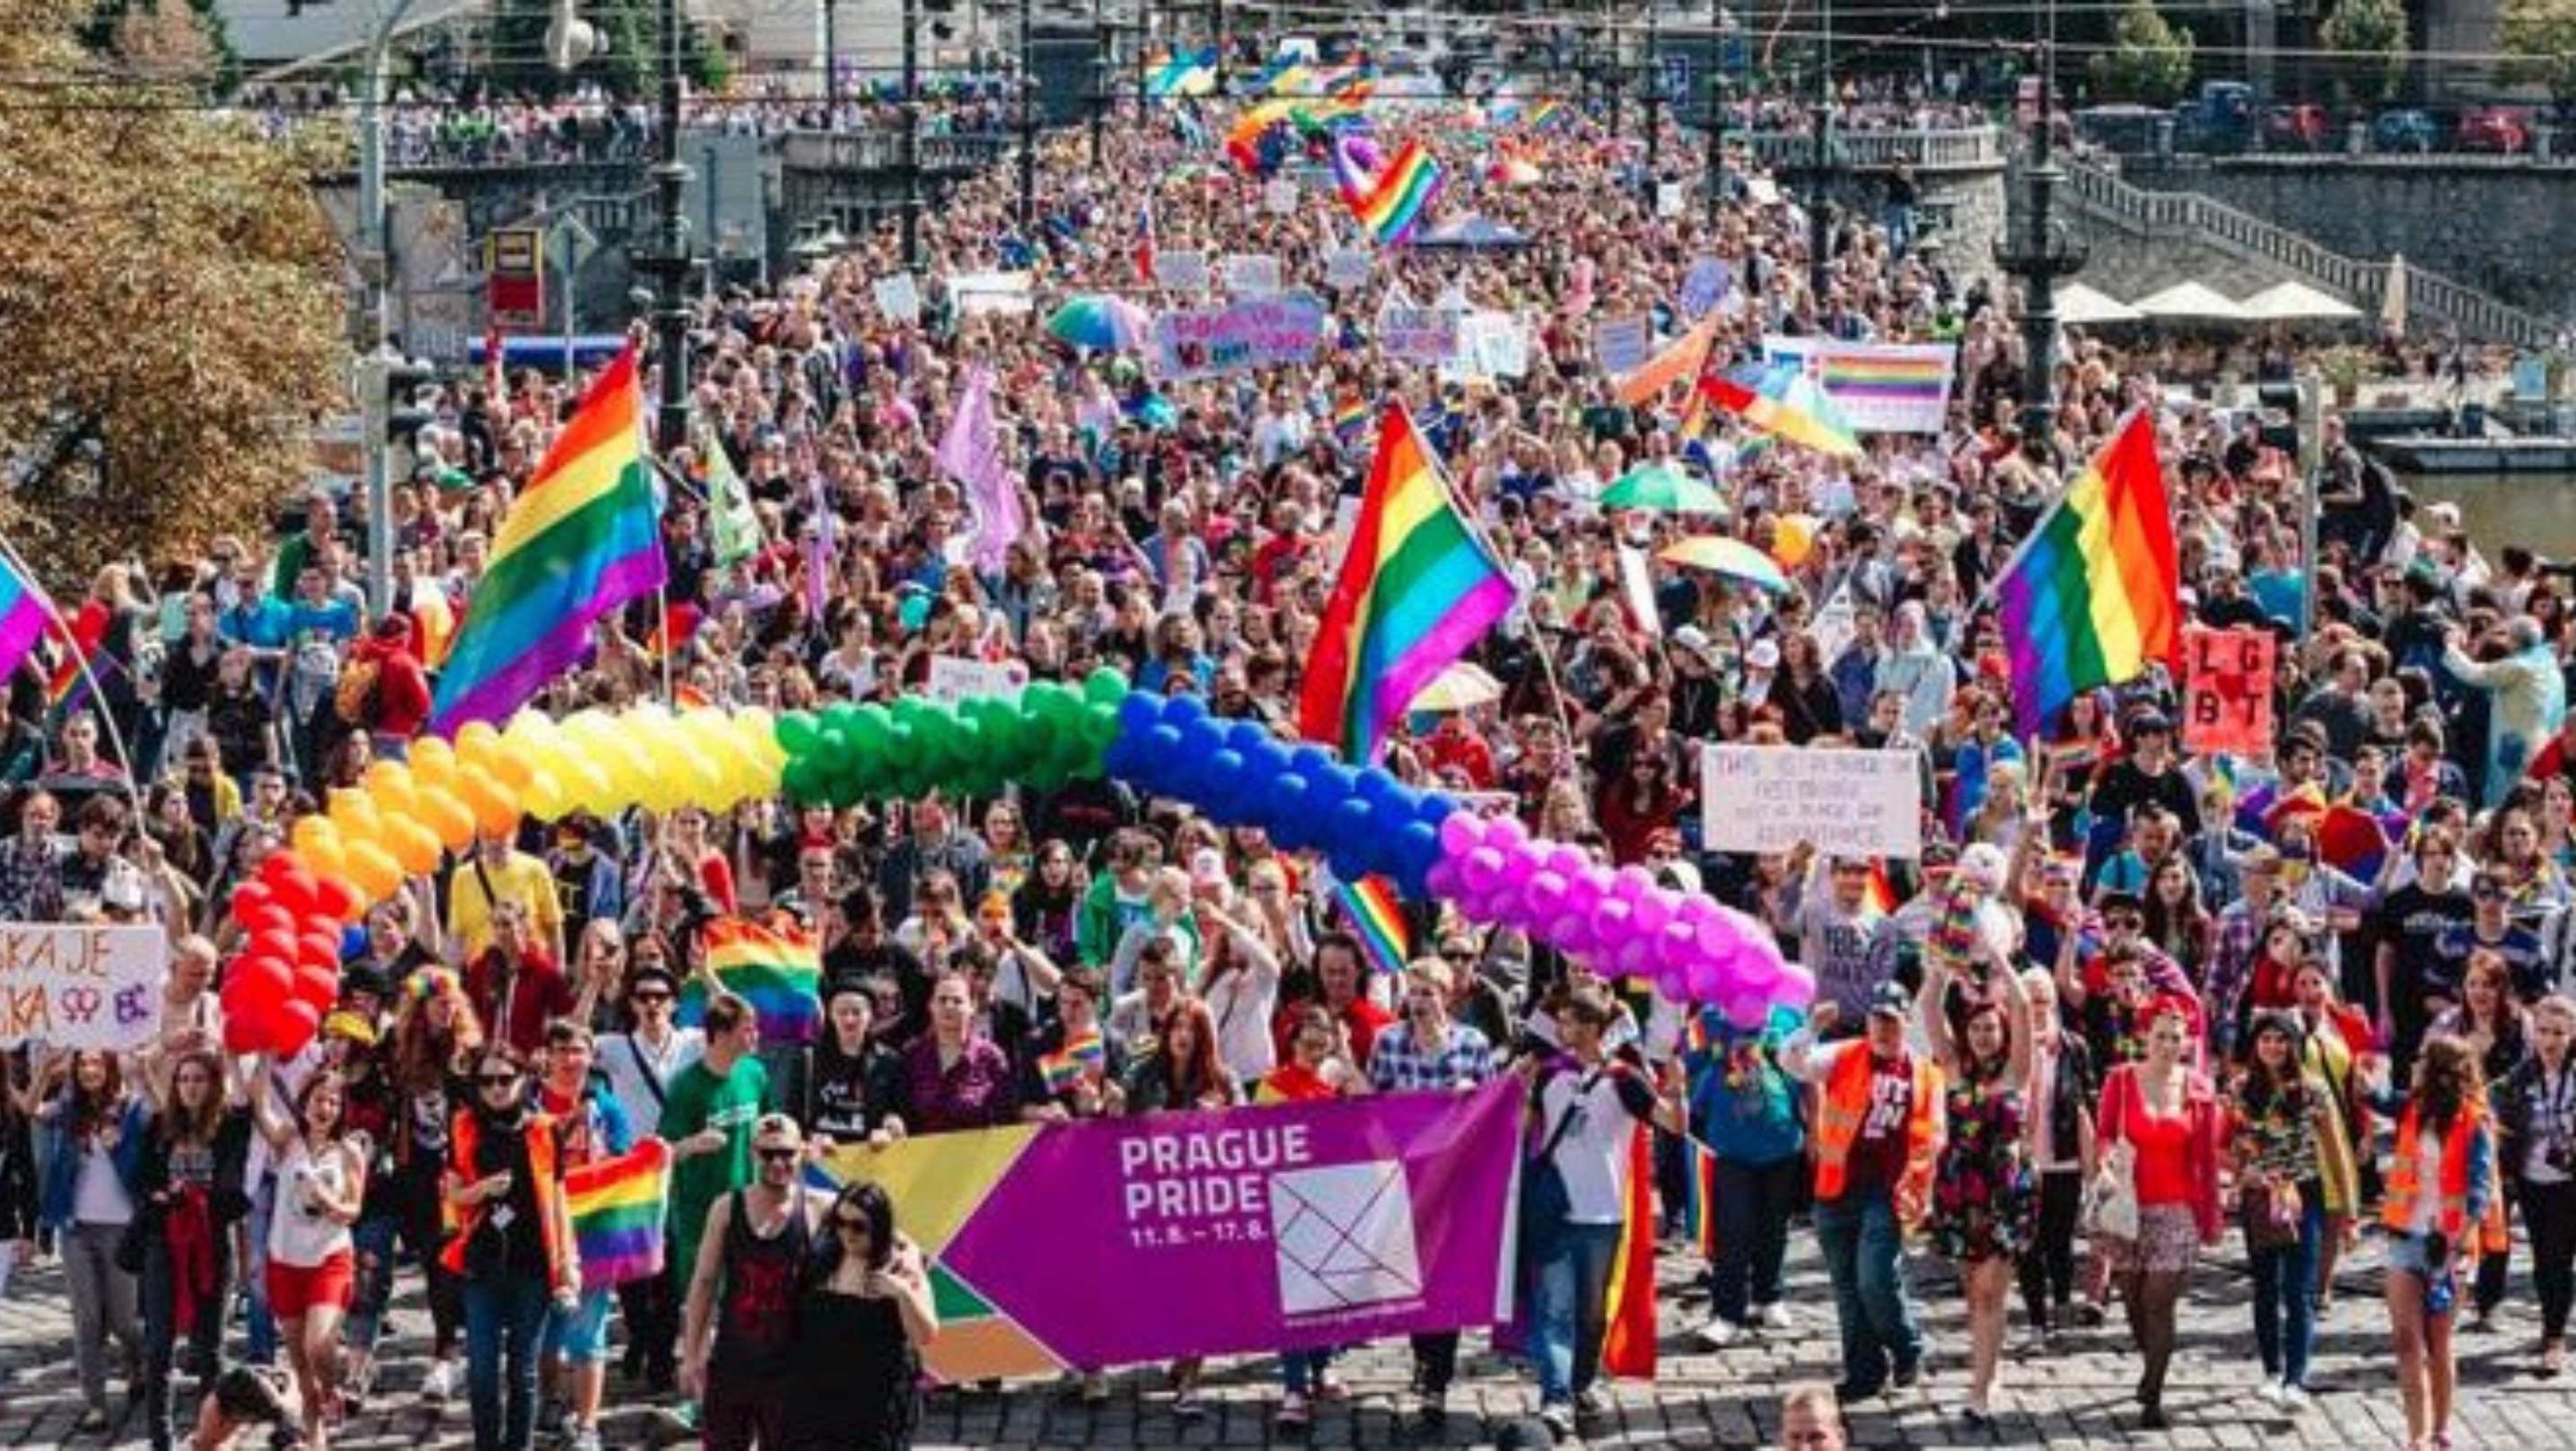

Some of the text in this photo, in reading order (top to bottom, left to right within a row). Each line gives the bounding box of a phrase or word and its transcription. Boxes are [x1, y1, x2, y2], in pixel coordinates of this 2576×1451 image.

[0, 931, 55, 971] KA
[1121, 1125, 1312, 1176] PRAGUE
[1125, 1174, 1266, 1220] PRIDE
